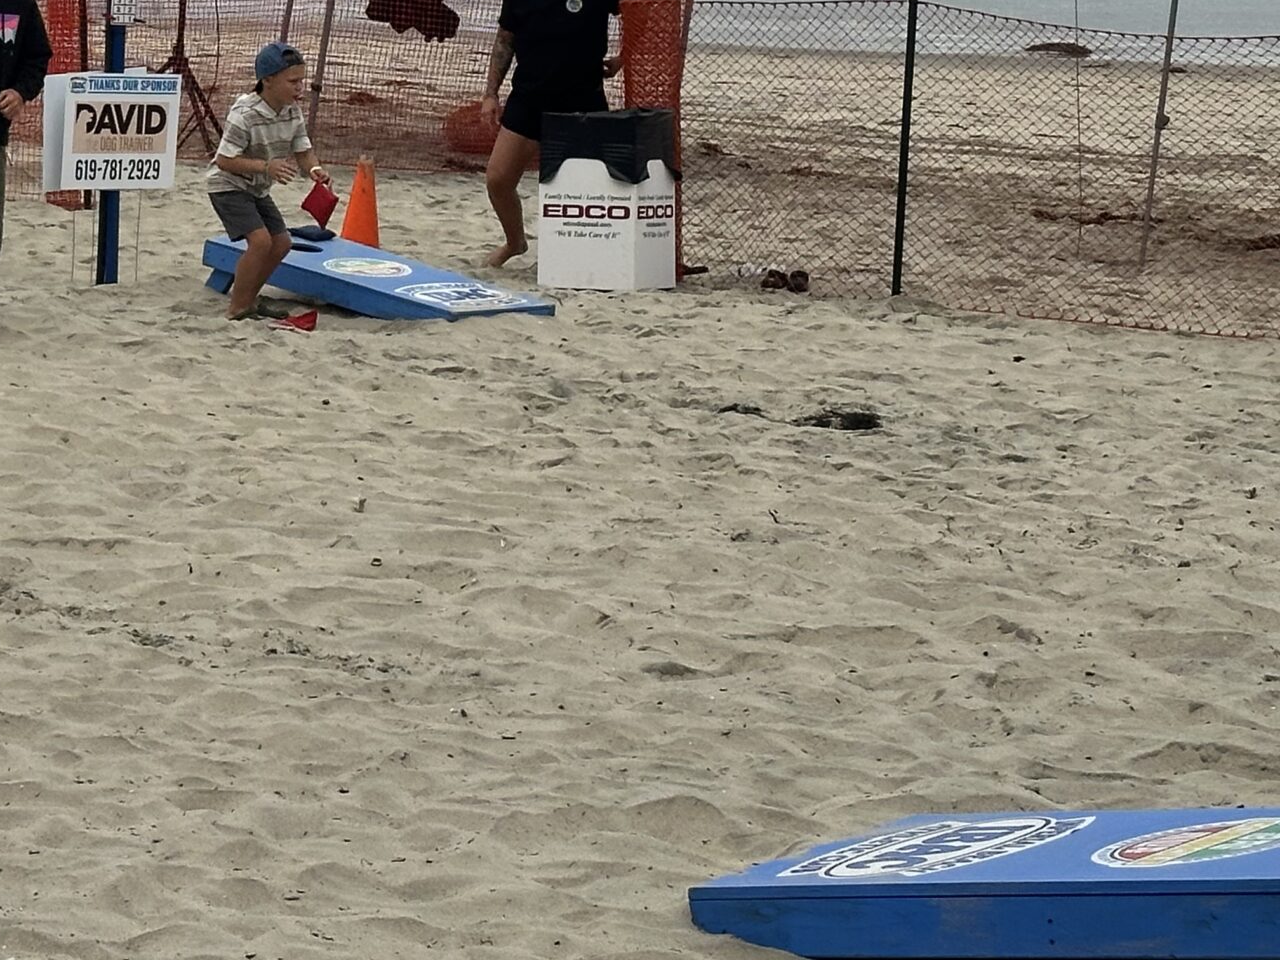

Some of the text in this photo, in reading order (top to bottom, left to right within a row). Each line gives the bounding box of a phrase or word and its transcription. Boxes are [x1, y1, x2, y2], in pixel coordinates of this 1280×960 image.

[89, 79, 178, 92] THANKS OUR SPONSOR
[76, 103, 167, 135] DAVID
[100, 136, 117, 152] DOG
[119, 136, 154, 152] TRAINER
[75, 159, 161, 181] 619-781-2929
[543, 204, 631, 220] EDCO
[637, 205, 673, 219] EDCO
